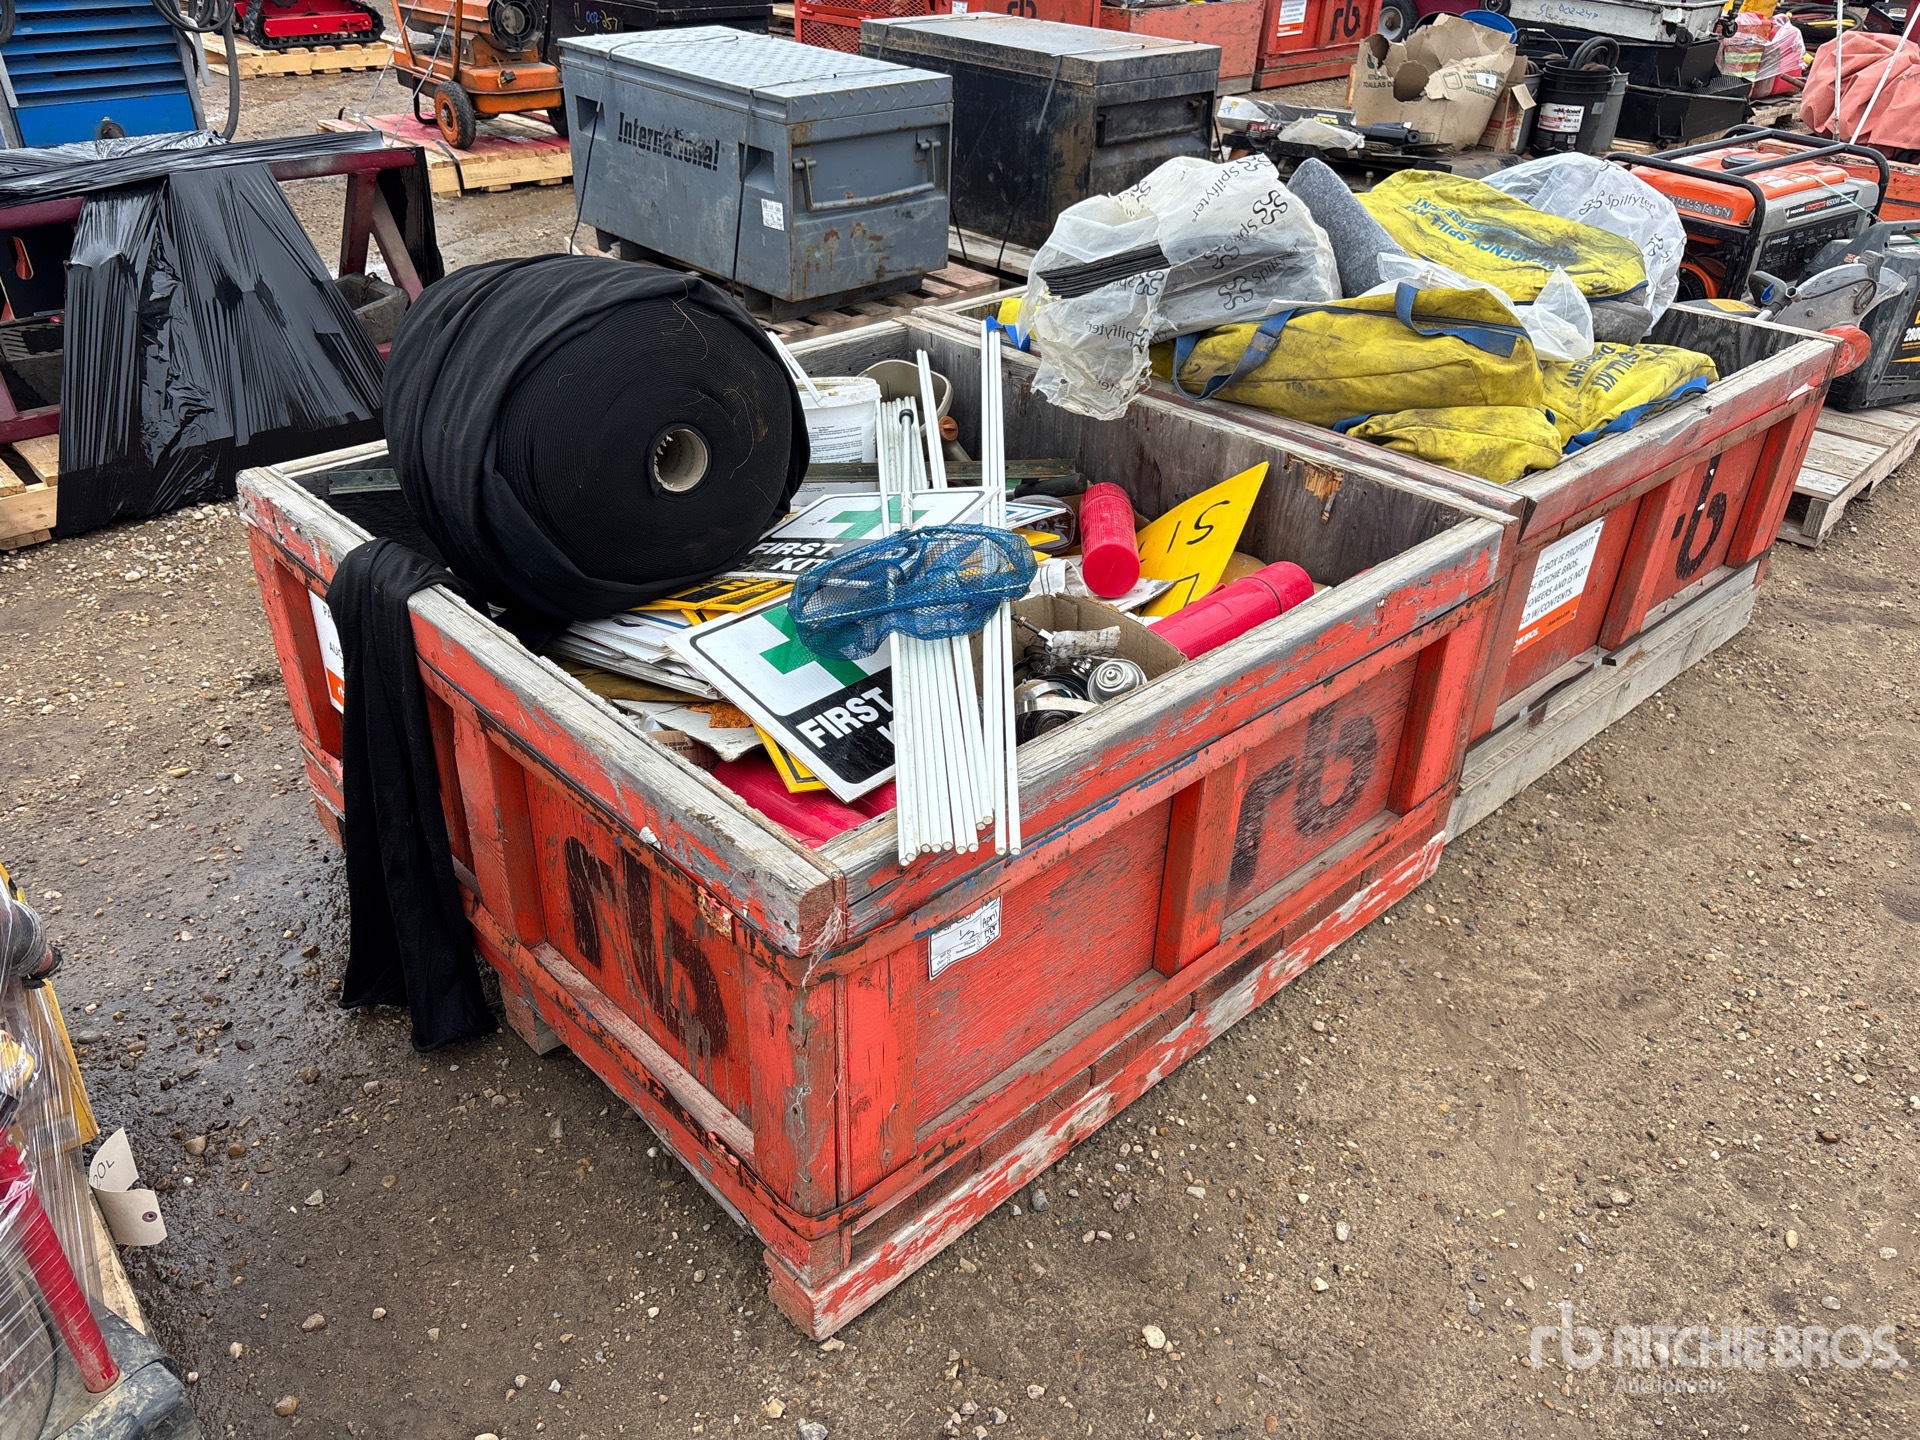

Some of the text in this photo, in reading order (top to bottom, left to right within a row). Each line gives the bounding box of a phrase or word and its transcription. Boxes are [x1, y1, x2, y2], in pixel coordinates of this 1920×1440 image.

[618, 111, 720, 172] International
[747, 542, 845, 557] FIRST
[1565, 535, 1597, 562] PROPERTY
[795, 686, 895, 750] FIRST
